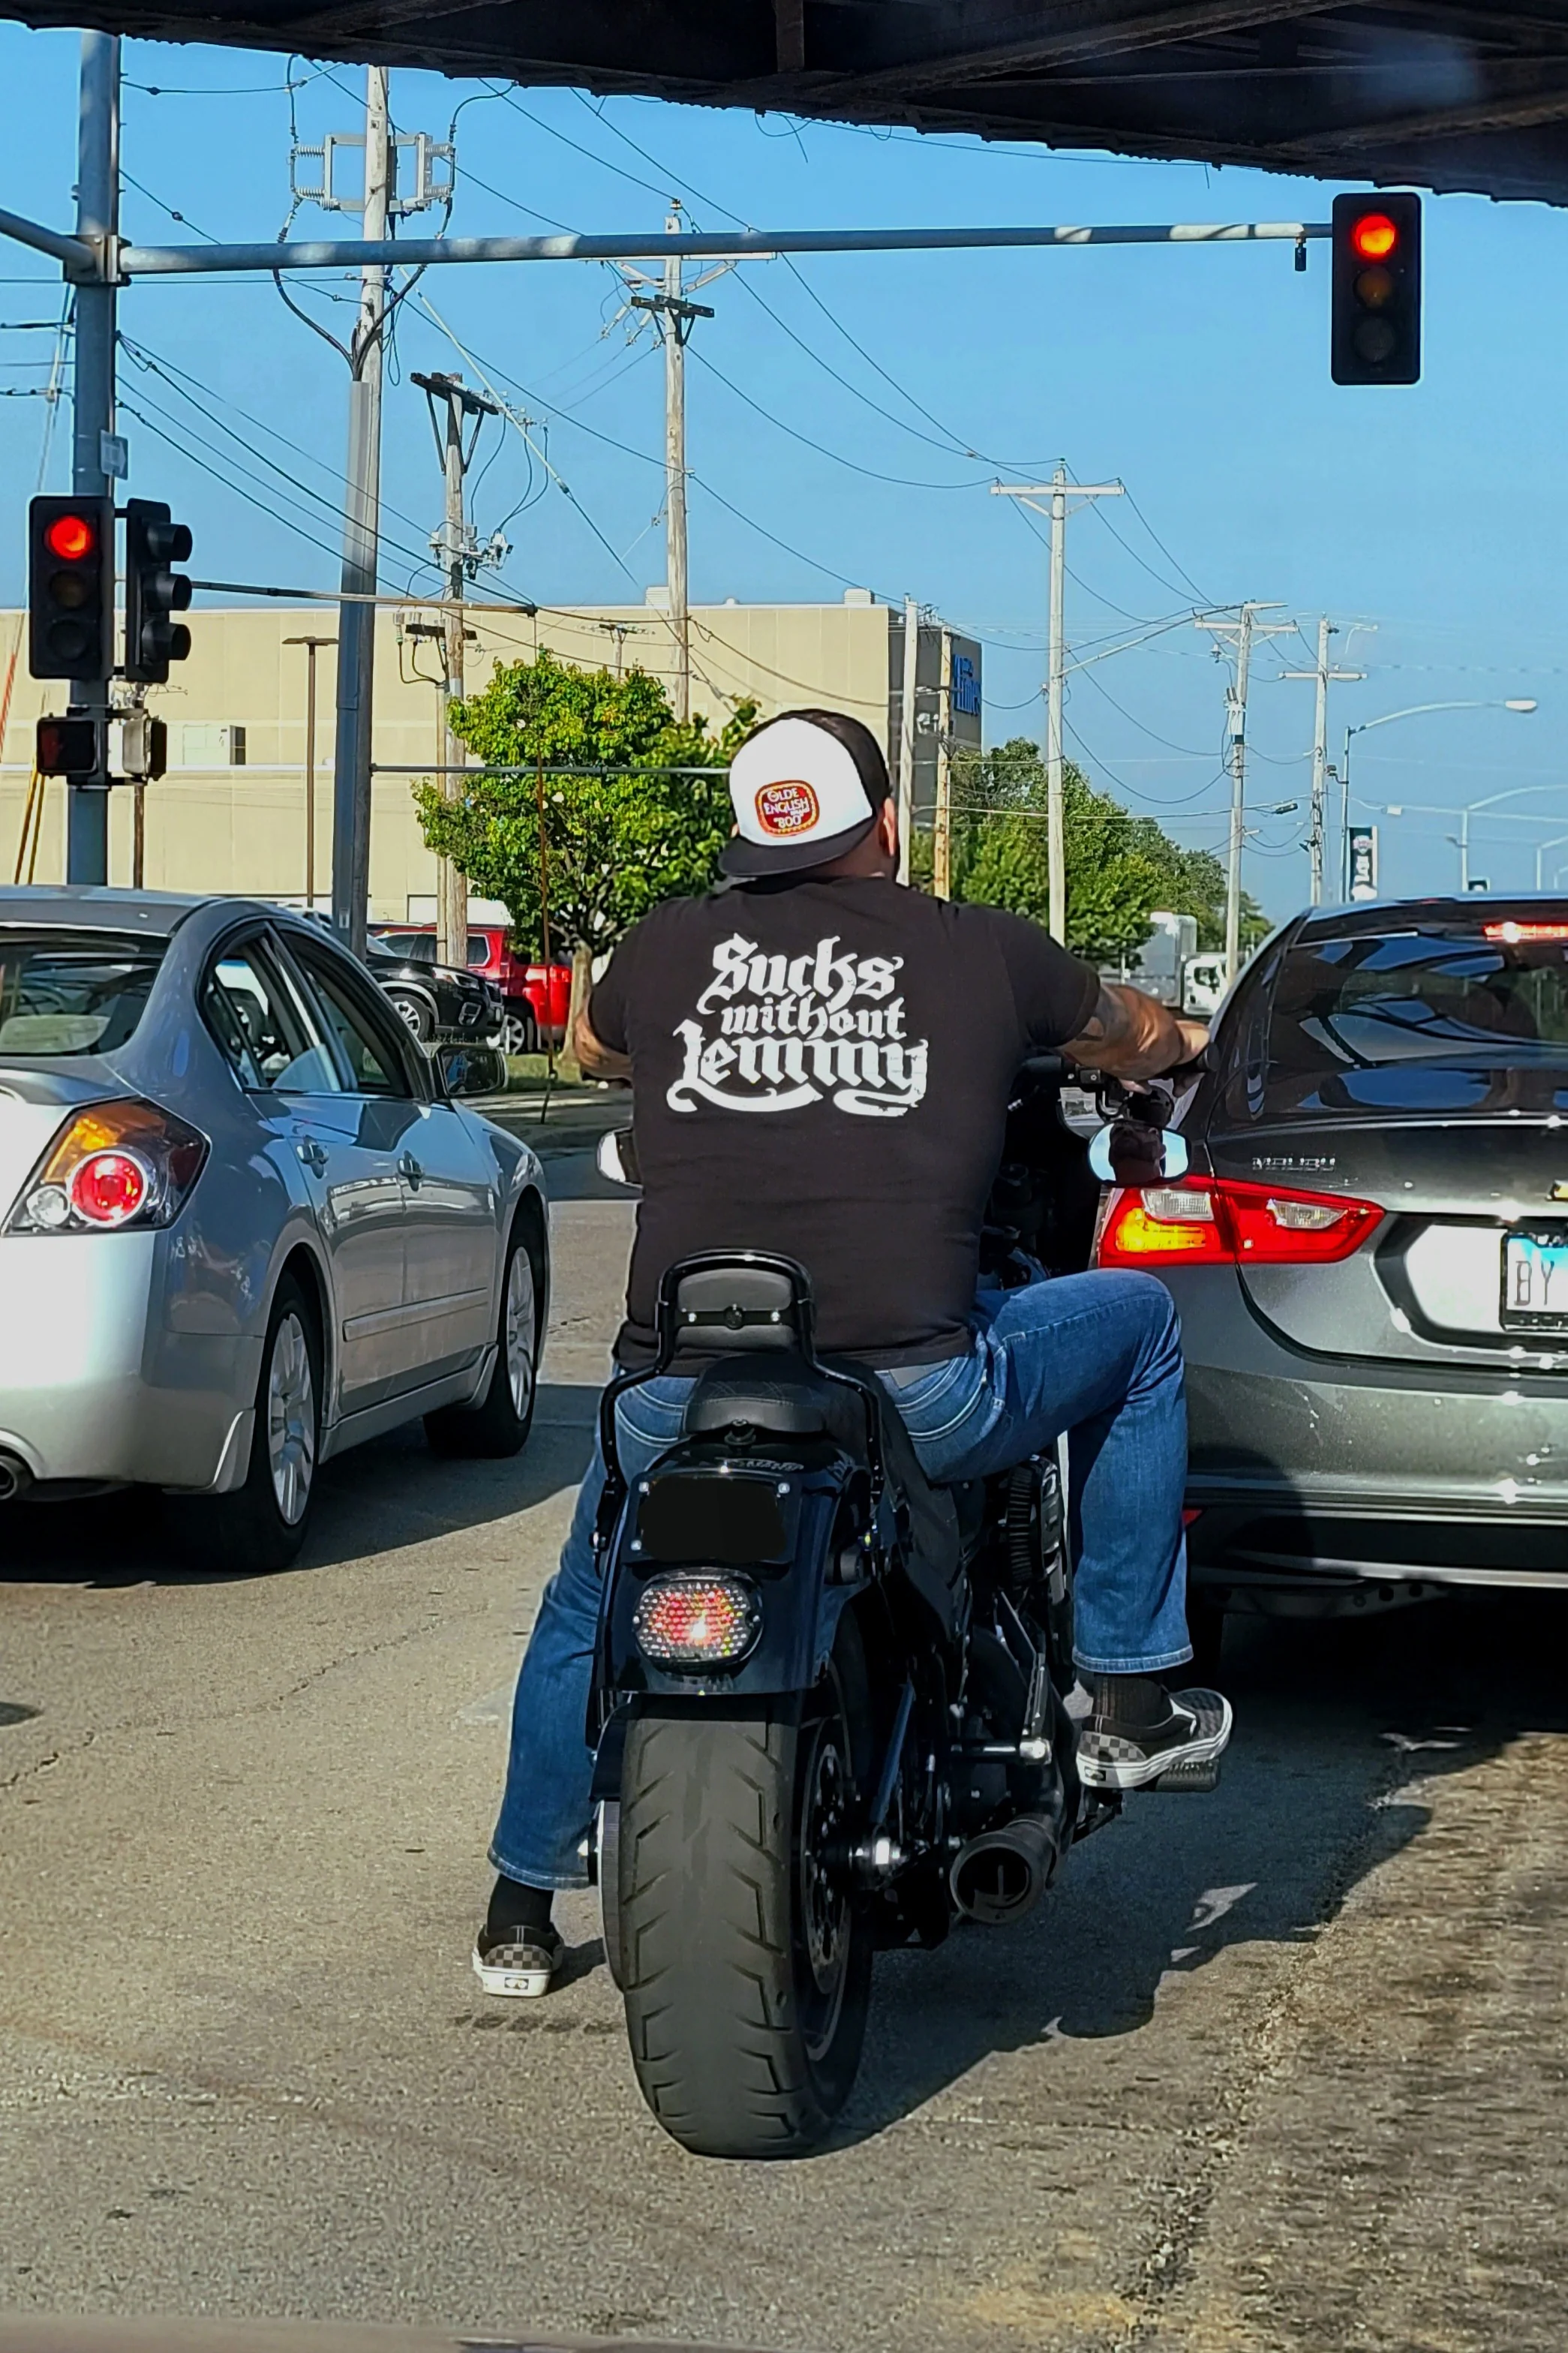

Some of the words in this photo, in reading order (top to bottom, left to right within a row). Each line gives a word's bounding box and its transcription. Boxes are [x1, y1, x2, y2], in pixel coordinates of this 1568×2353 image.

[767, 788, 799, 803] OLDE
[696, 933, 903, 1014] Sucks
[721, 992, 906, 1040] without
[666, 1019, 928, 1116] Lemmy
[1252, 1157, 1335, 1172] MALIBU
